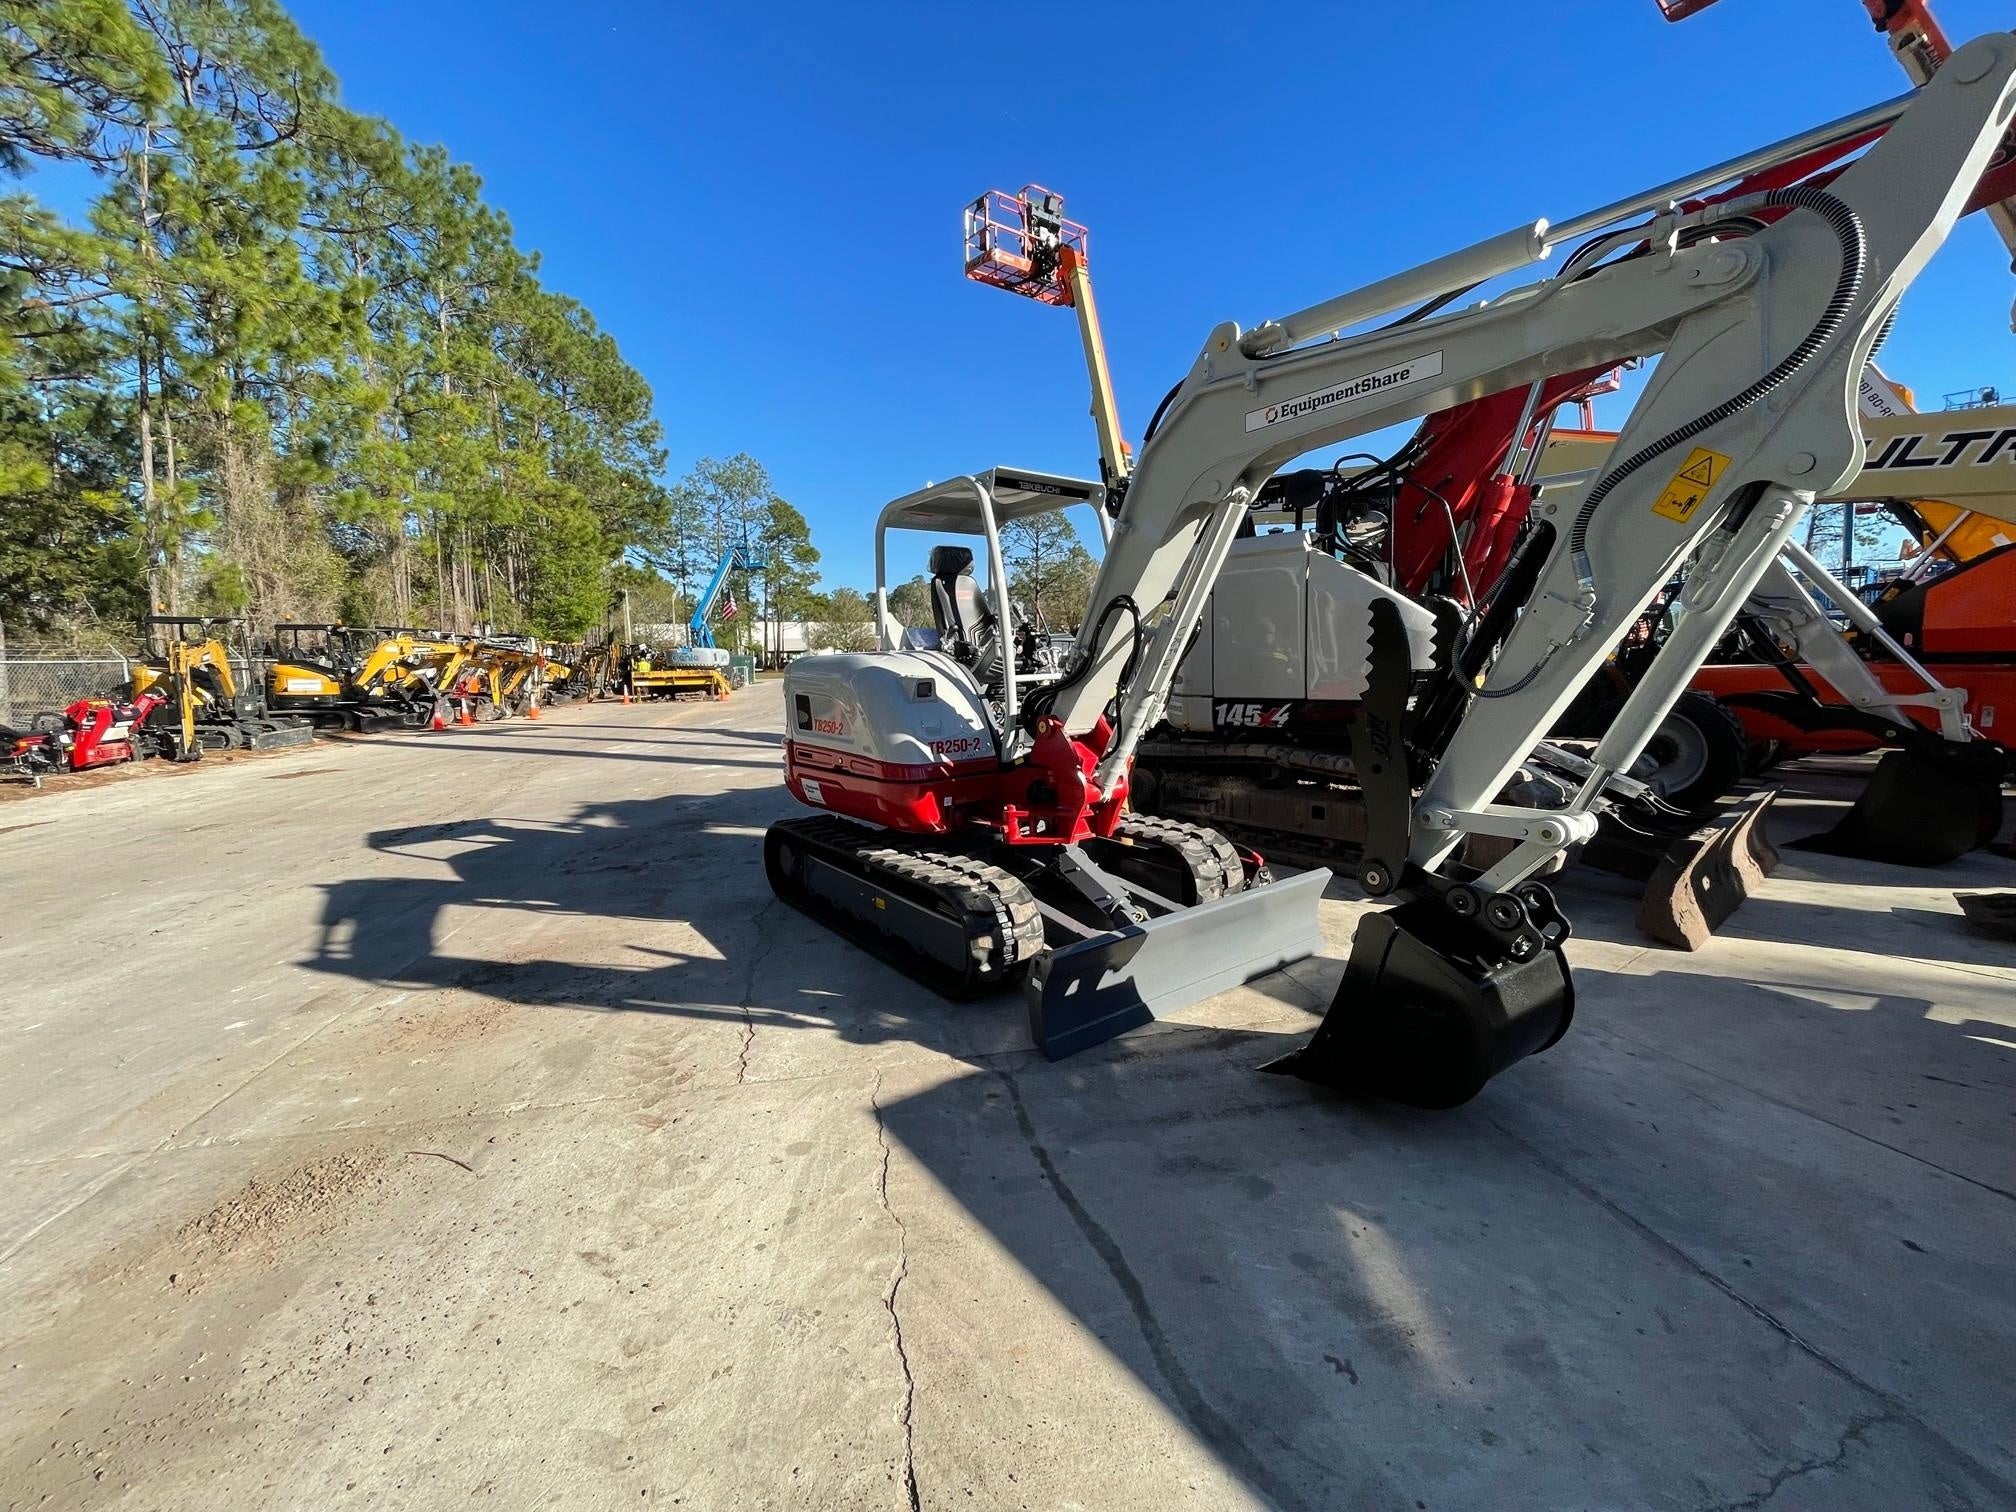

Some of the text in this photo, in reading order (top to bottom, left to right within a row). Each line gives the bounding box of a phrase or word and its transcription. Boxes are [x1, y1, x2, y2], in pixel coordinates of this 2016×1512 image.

[1018, 481, 1061, 494] TAKEUCHI
[814, 719, 844, 736] TB250-2
[928, 737, 981, 755] TB250-2
